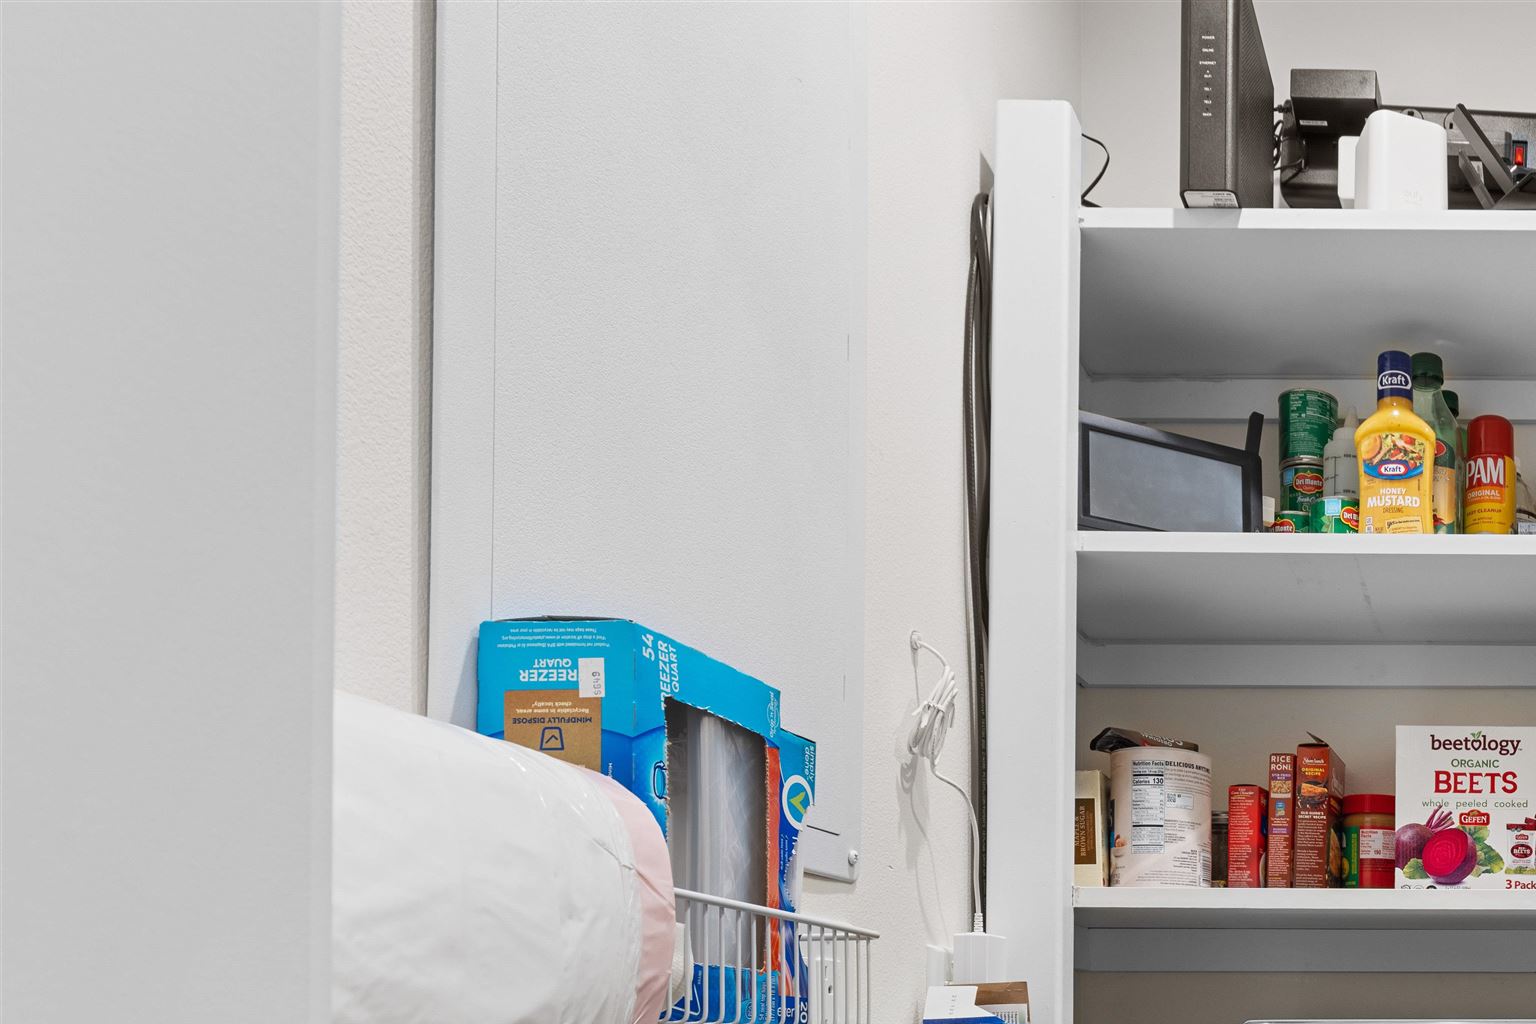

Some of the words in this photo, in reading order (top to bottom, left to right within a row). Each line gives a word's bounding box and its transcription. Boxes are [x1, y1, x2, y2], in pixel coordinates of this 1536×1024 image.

[1382, 375, 1406, 386] Kraft
[1466, 457, 1504, 489] PAM
[1468, 490, 1501, 498] ORIGINAL
[1367, 495, 1421, 508] MUSTARD
[642, 633, 655, 662] 54
[533, 658, 572, 668] QUART
[669, 643, 680, 693] QUART
[1430, 731, 1521, 756] beetology
[803, 747, 811, 775] done
[1165, 761, 1194, 769] DELICIOUS
[1270, 755, 1291, 763] RICE
[1451, 758, 1500, 769] ORGANIC
[1433, 770, 1518, 794] BEETS
[1421, 800, 1449, 808] whole
[1455, 800, 1488, 809] peeled
[1494, 799, 1528, 808] cooked
[1079, 805, 1087, 830] SUGAR
[1460, 813, 1488, 824] GEFEN
[1079, 830, 1087, 857] BROWN
[1505, 880, 1512, 889] 3
[1514, 880, 1536, 889] Pack
[799, 1001, 808, 1024] 20
